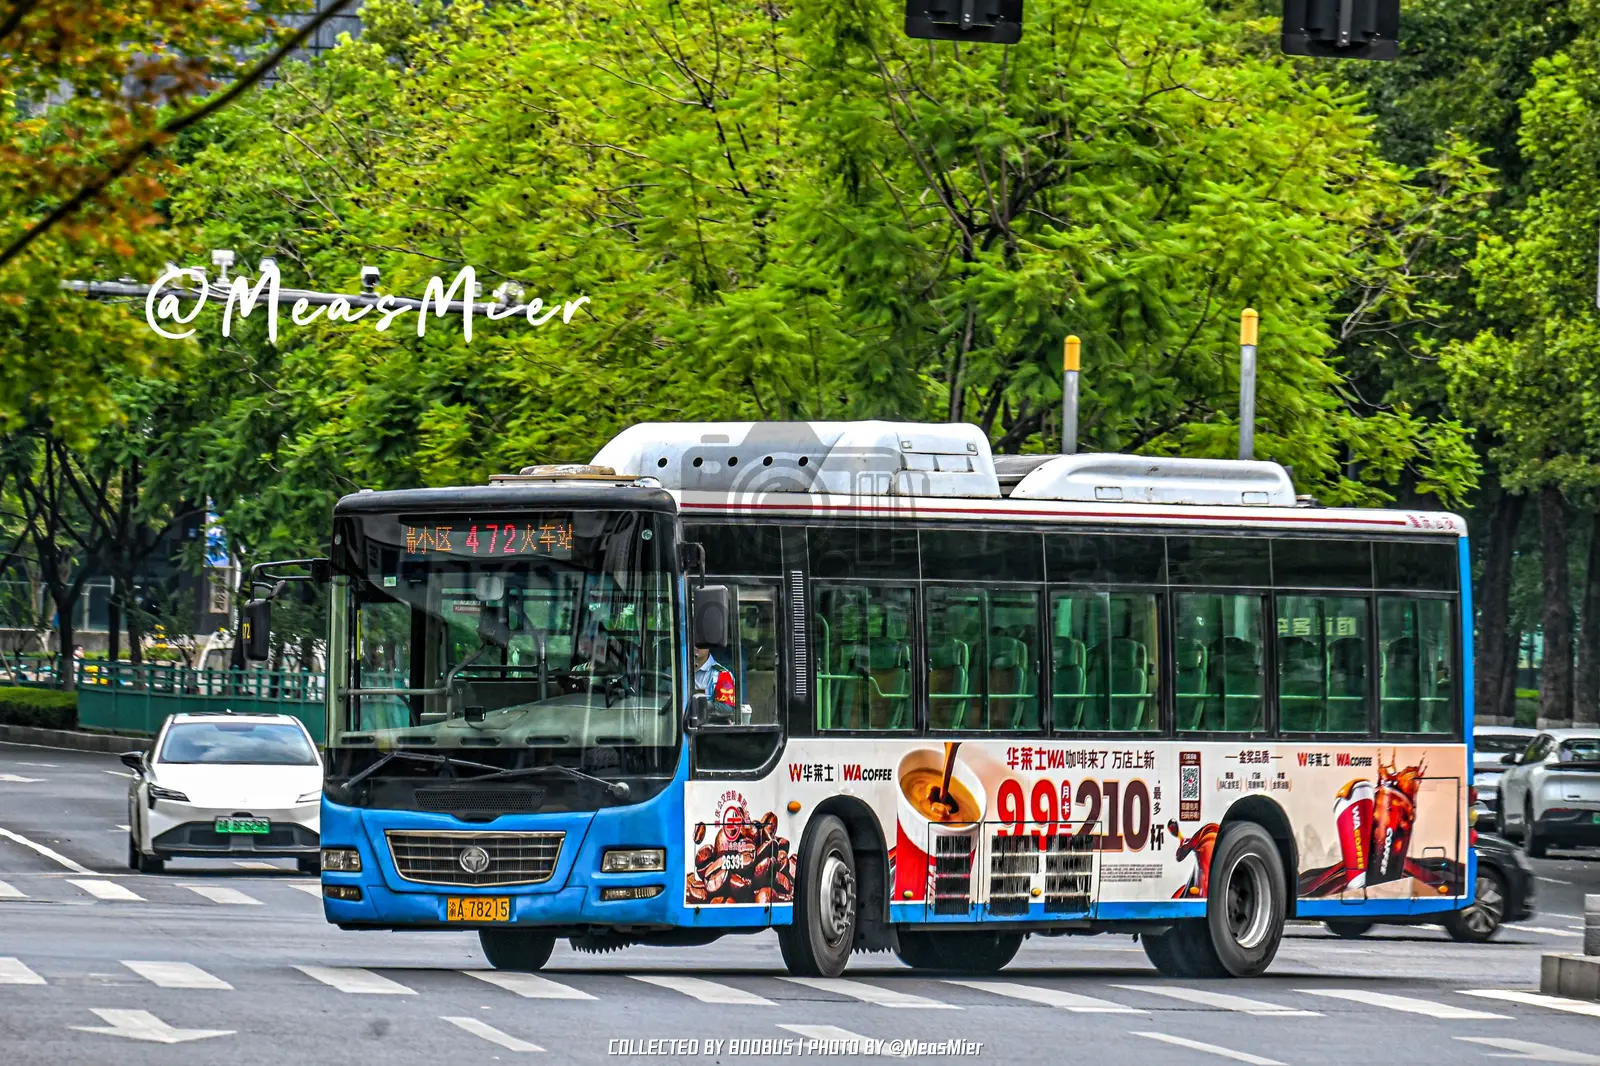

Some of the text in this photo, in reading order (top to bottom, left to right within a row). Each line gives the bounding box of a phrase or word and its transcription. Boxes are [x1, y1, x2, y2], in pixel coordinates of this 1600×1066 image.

[465, 523, 517, 554] 472
[520, 523, 574, 553] 火车站
[1112, 750, 1155, 770] 万店上新
[1239, 750, 1270, 764] 金奖品质
[1062, 785, 1071, 817] 月卡
[1075, 778, 1151, 852] 210
